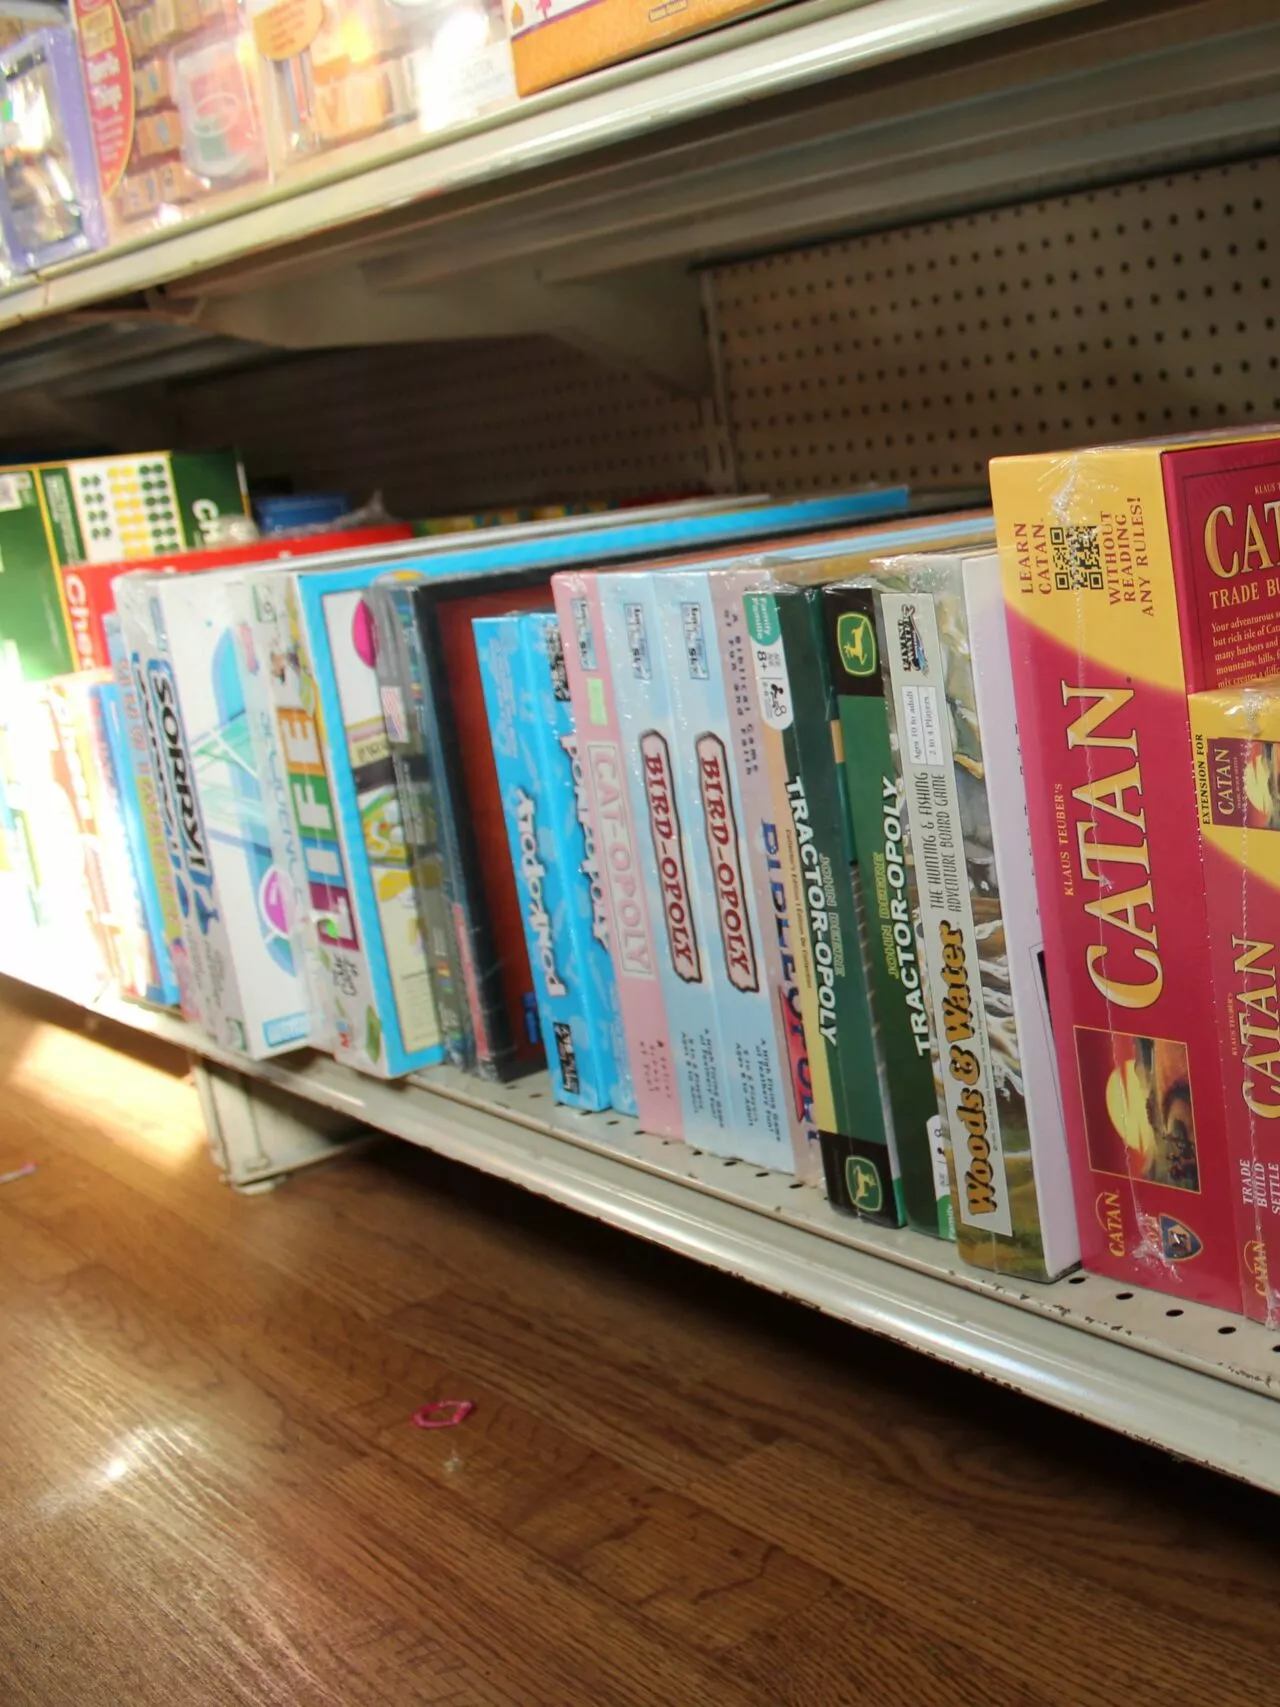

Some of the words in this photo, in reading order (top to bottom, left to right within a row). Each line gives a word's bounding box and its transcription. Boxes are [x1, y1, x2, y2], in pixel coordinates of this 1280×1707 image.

[1014, 522, 1034, 594] LEARN
[1100, 511, 1121, 606] WITHOUT
[1115, 514, 1136, 602] READING
[1126, 497, 1148, 567] RULES!
[1139, 577, 1154, 617] ANY
[1209, 582, 1260, 610] TRADE
[1211, 622, 1229, 633] Your
[1230, 613, 1274, 629] adventurous
[756, 650, 768, 670] 8+
[1212, 636, 1227, 647] but
[1227, 631, 1243, 643] rich
[913, 739, 921, 760] Ages
[1195, 734, 1204, 756] FOR
[914, 771, 933, 817] FISHING
[931, 773, 947, 805] GAME
[1199, 760, 1211, 825] EXTENSION
[1214, 748, 1235, 815] CATAN
[936, 812, 955, 848] BOARD
[1054, 783, 1069, 845] TEUBER'S
[1061, 678, 1164, 1009] CATAN
[594, 752, 650, 970] CAT-OPOLY
[645, 753, 693, 966] BIRD-OPOLY
[701, 756, 750, 975] BIRD-OPOLY
[920, 834, 940, 886] HUNTING
[940, 849, 962, 913] ADVENTURE
[1063, 852, 1074, 896] KLAUS
[786, 776, 837, 1045] TRACTOR-OPOLY
[819, 853, 837, 907] JOHN
[829, 913, 845, 977] DEERE
[883, 776, 931, 1056] TRACTOR-OPOLY
[930, 887, 944, 910] THE
[881, 925, 899, 979] JOHN
[939, 919, 975, 1044] Water
[949, 1045, 981, 1086] &
[957, 1086, 998, 1216] Woods
[1239, 1158, 1254, 1205] TRADE
[1253, 1163, 1268, 1209] BUILD
[1106, 1192, 1125, 1257] CATAN
[1251, 1241, 1269, 1298] CATAN
